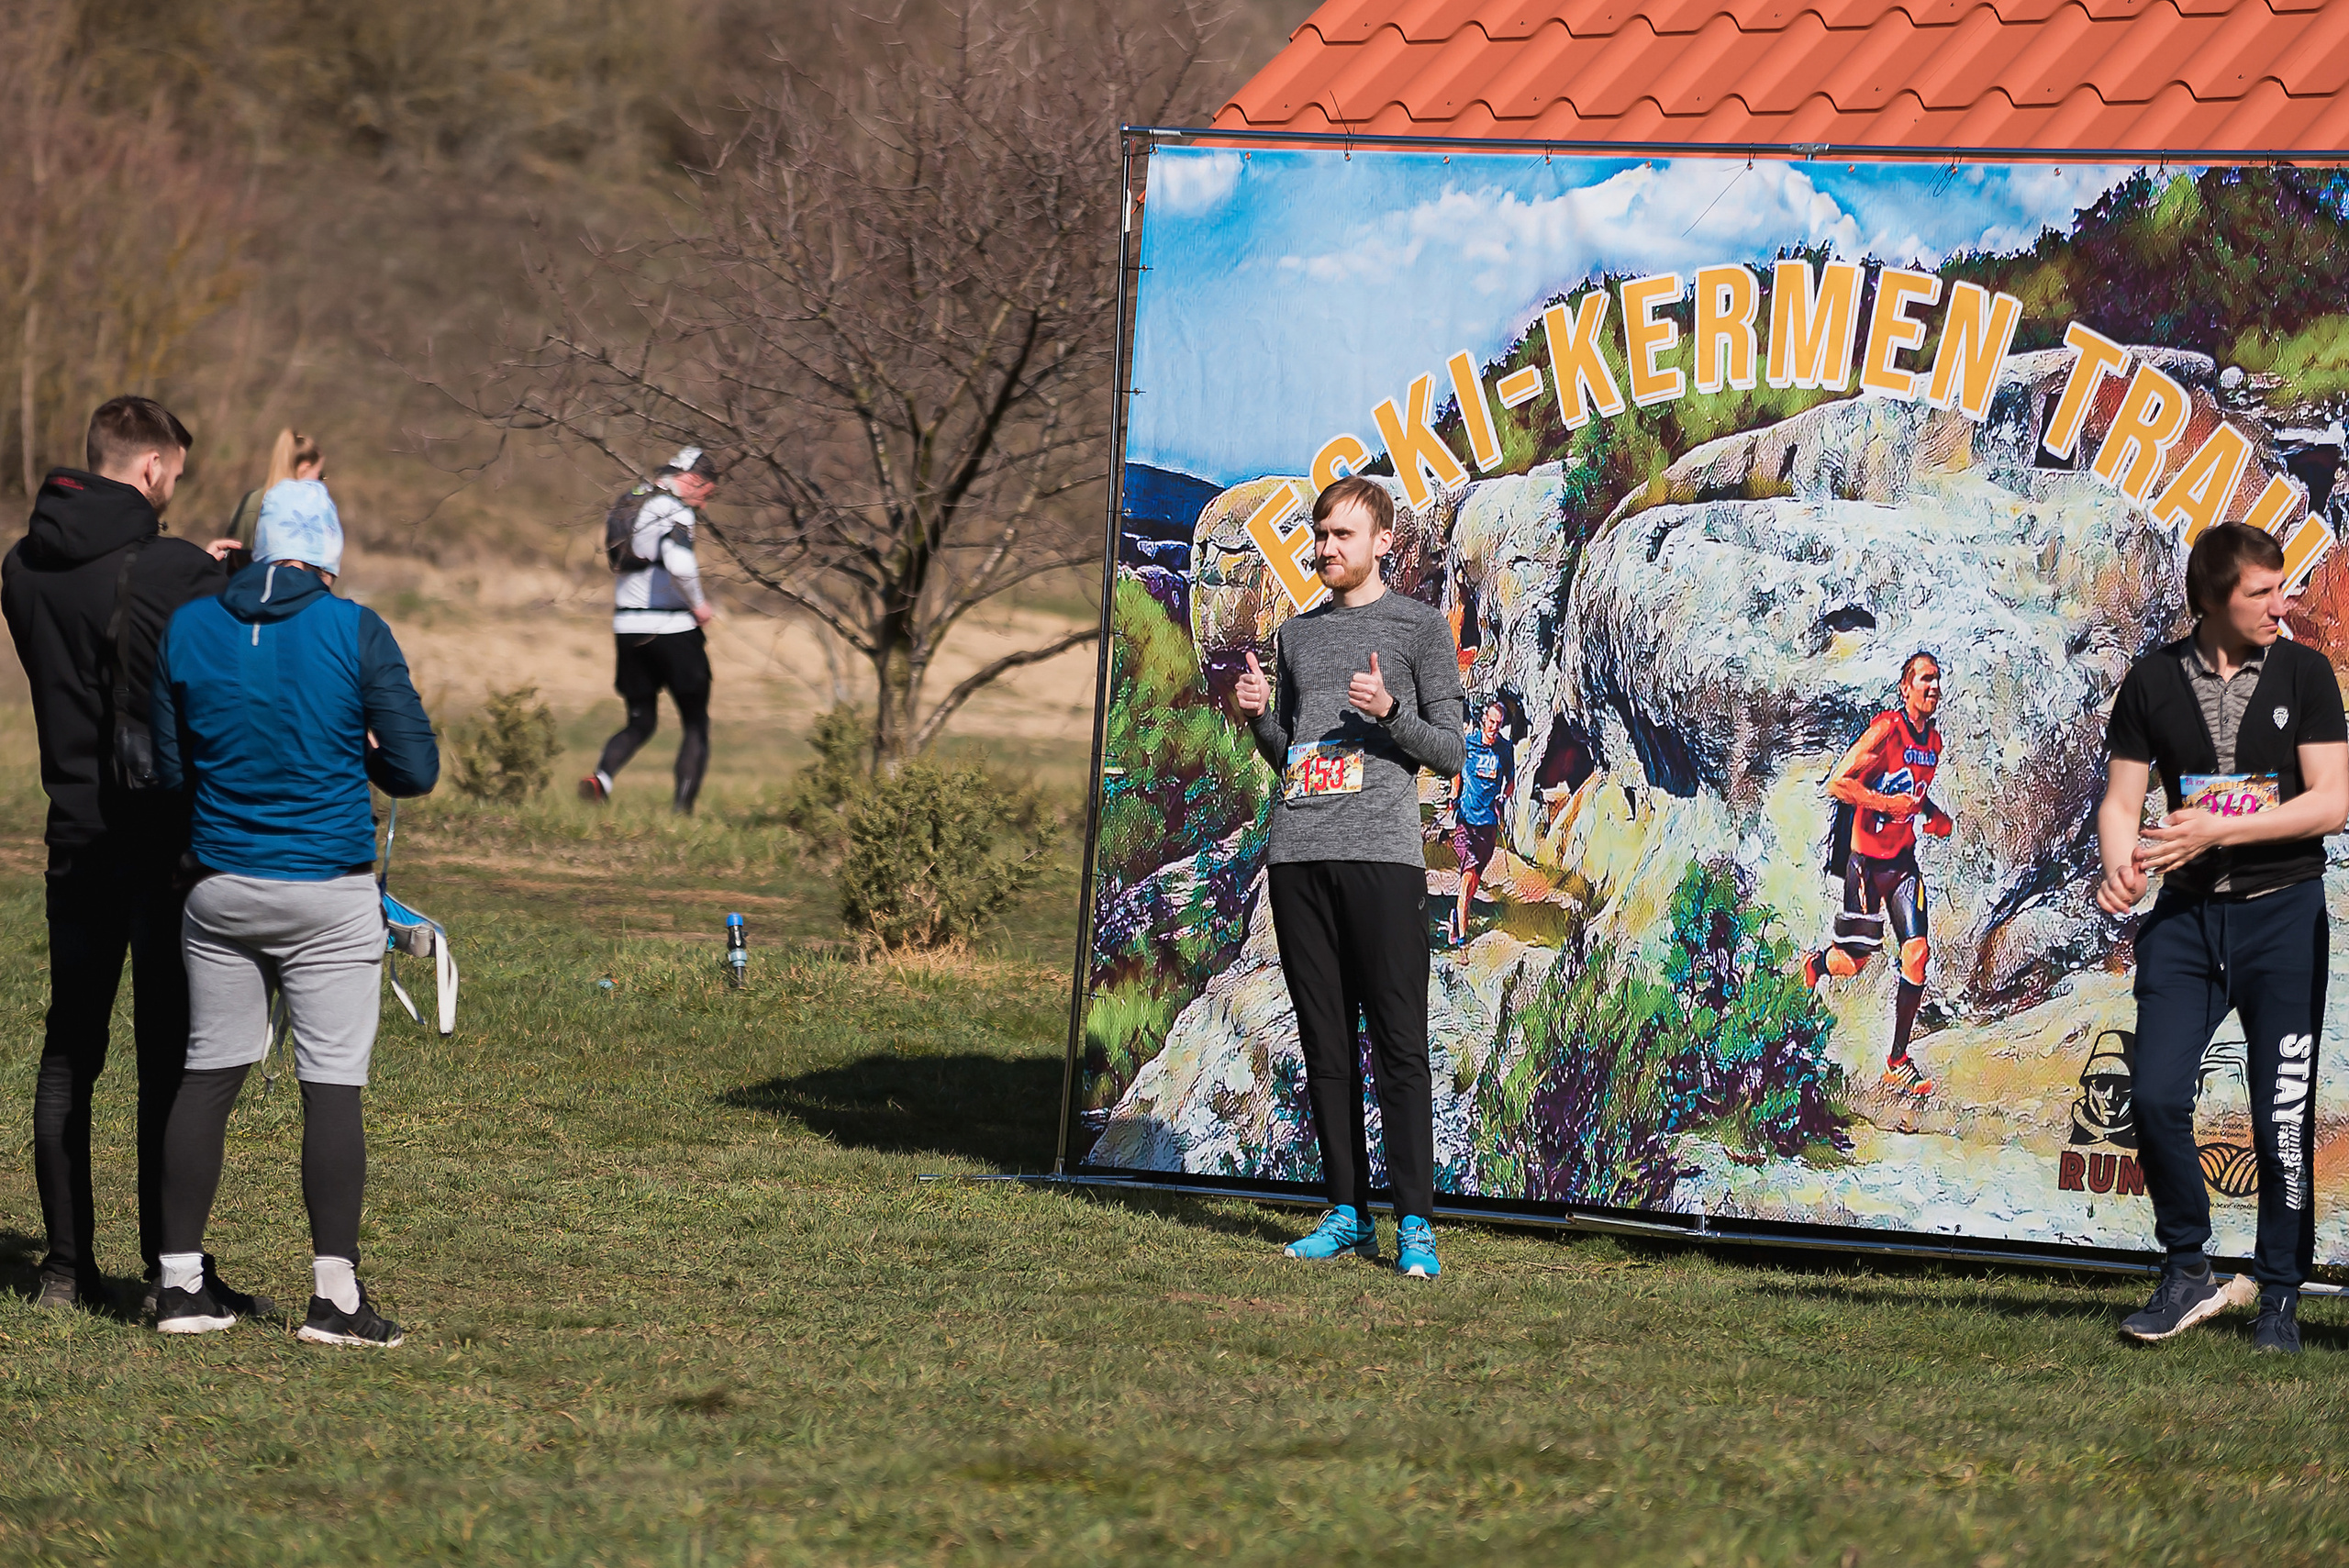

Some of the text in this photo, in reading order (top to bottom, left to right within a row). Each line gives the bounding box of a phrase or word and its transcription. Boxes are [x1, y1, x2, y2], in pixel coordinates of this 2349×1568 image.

[1302, 756, 1345, 792] 153
[1475, 754, 1497, 770] 220
[2271, 1033, 2314, 1124] STAY
